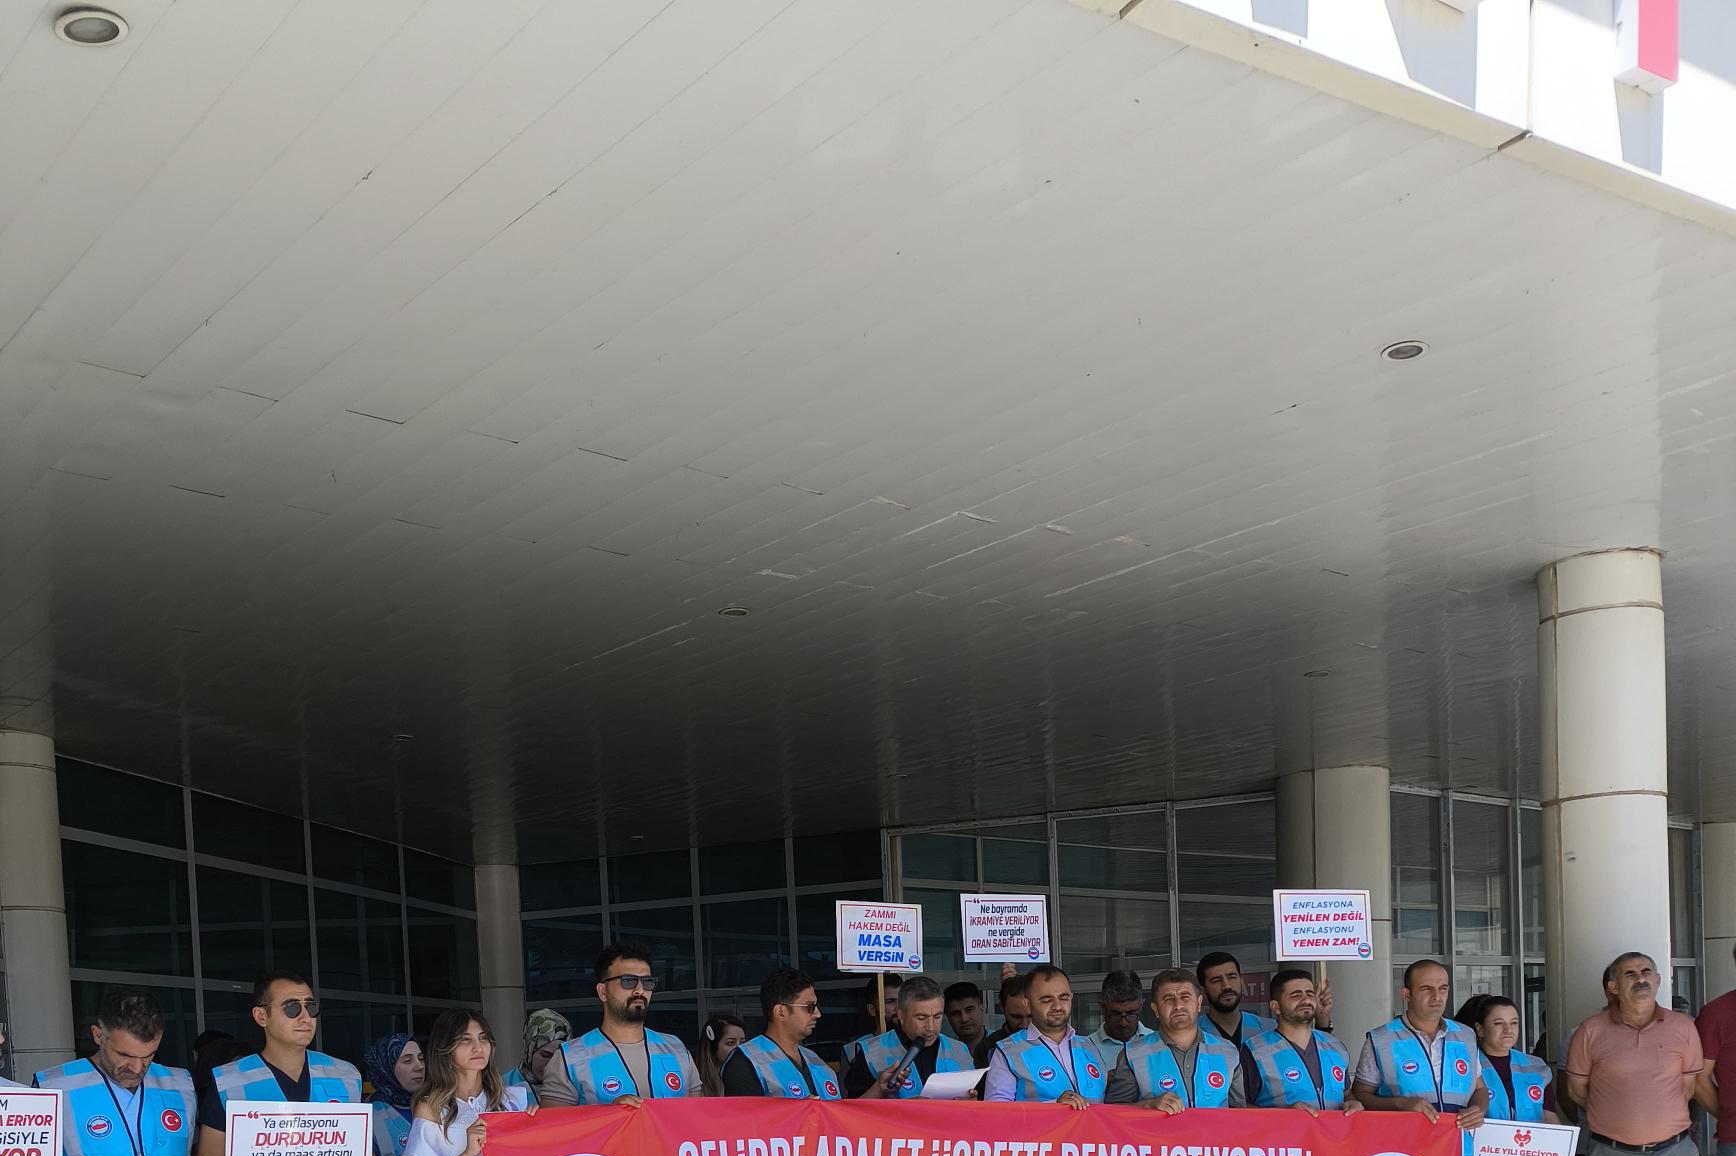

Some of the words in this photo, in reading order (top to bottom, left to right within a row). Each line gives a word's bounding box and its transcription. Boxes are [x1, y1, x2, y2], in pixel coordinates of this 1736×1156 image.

[980, 904, 990, 914] Ne
[992, 904, 1028, 915] bayramda
[1292, 900, 1354, 909] ENFLASYONA
[864, 910, 896, 919] ZAMMI
[1283, 912, 1330, 922] YENİLEN
[1333, 910, 1364, 921] DEĞİL
[849, 922, 883, 931] HAKEM
[885, 922, 911, 932] DEĞİL
[998, 926, 1024, 938] vergide
[1294, 925, 1354, 934] ENFLASYONU
[858, 934, 902, 948] MASA
[972, 939, 991, 948] ORAN
[1292, 938, 1330, 947] YENEN
[1332, 937, 1360, 946] ZAM!
[263, 1118, 276, 1129] Ya
[279, 1117, 338, 1130] enflasyonu
[255, 1131, 346, 1147] DURDURUN
[1480, 1146, 1500, 1154] AİLE
